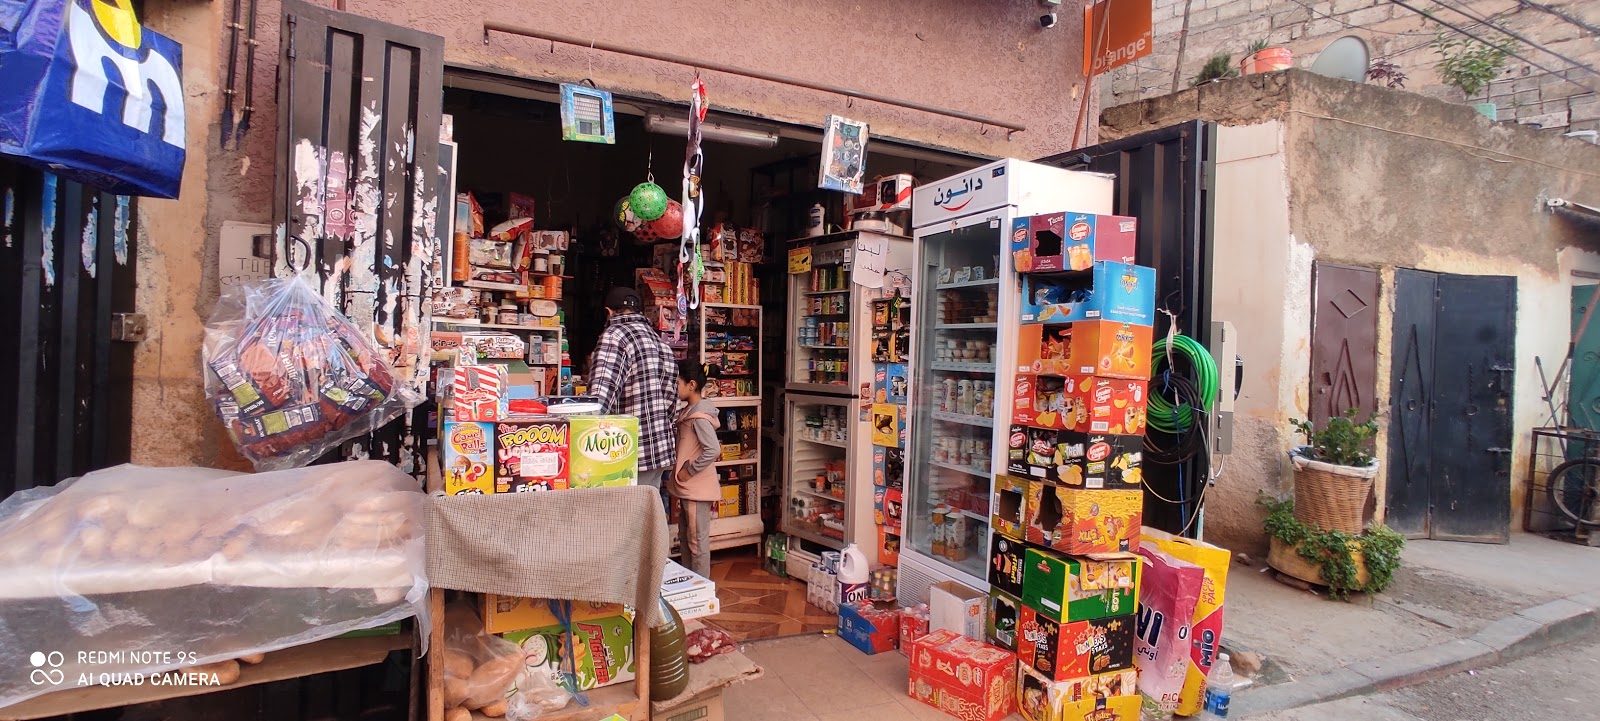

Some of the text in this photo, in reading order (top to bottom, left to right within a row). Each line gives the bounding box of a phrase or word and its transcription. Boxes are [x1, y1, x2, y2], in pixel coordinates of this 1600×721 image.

[933, 177, 983, 206] دانون
[500, 424, 567, 449] BOOOM
[585, 431, 628, 455] Mojito
[576, 622, 610, 685] FIGHTER
[1200, 629, 1215, 667] MIO
[1161, 692, 1179, 702] PAC
